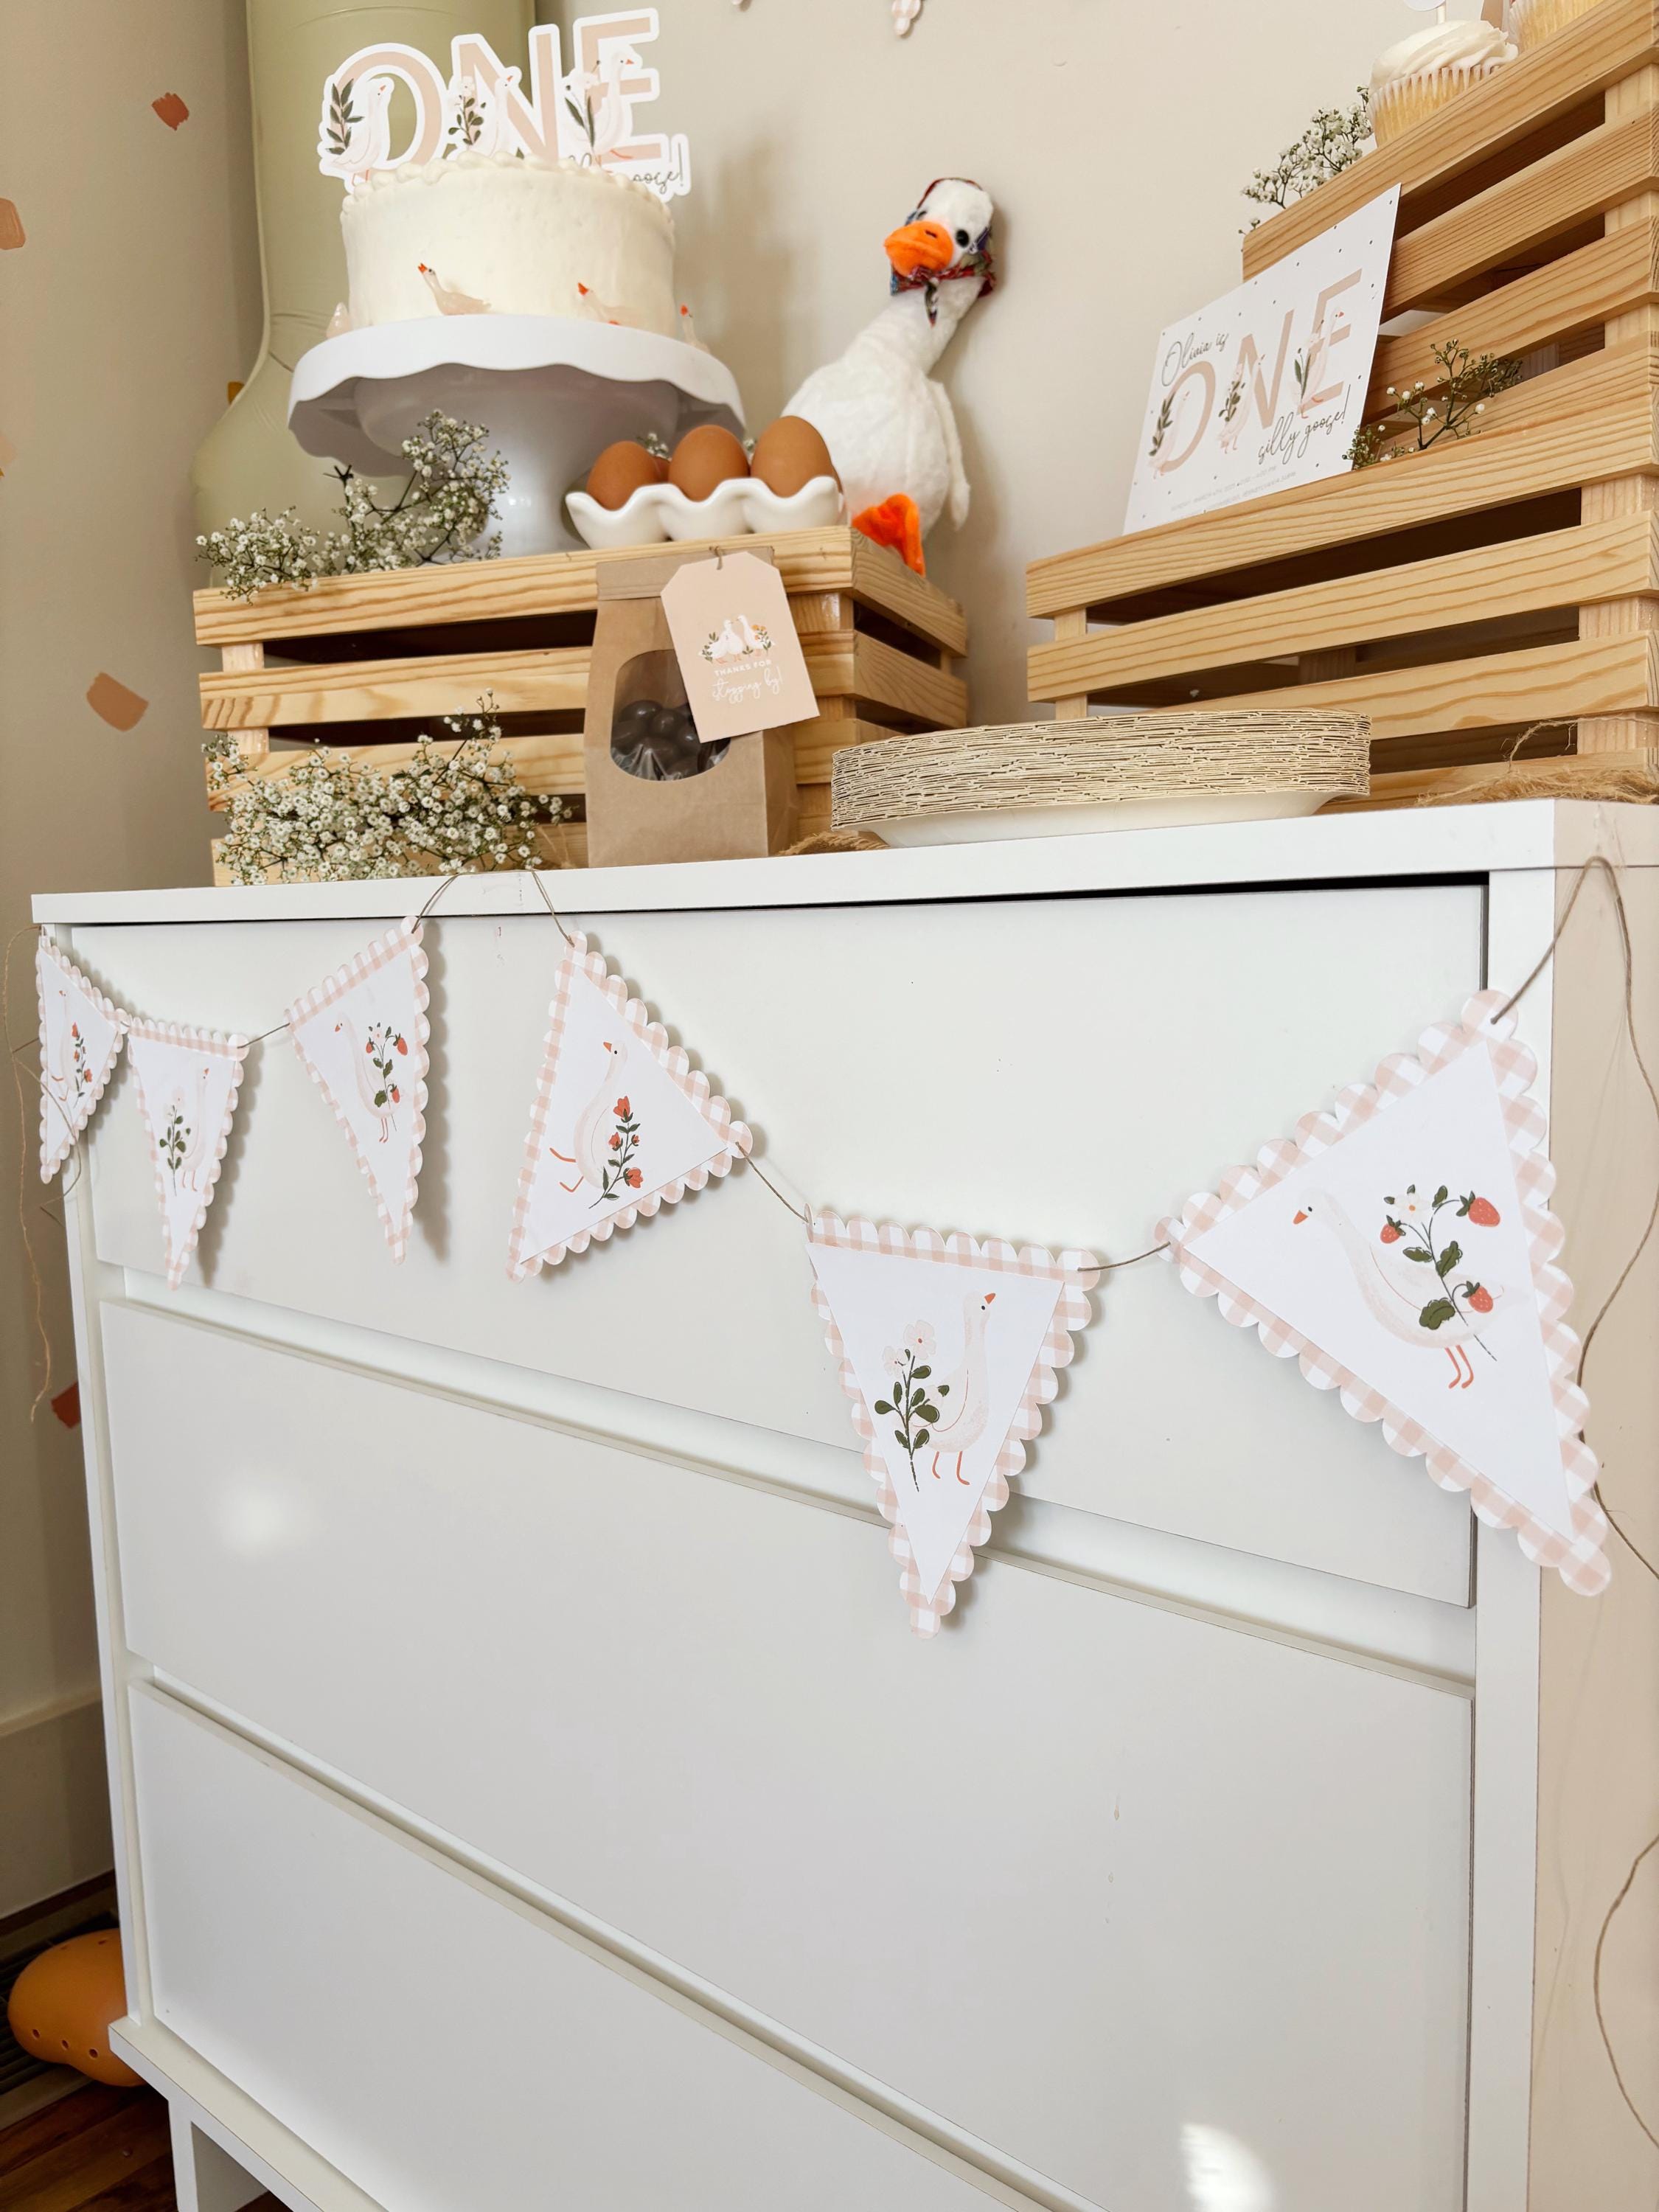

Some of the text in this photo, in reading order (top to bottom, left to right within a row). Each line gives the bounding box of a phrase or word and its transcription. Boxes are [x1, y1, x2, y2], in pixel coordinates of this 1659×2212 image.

[329, 16, 663, 165] ONE
[631, 142, 684, 195] oose!
[1155, 268, 1363, 473] ONE
[1161, 332, 1230, 387] Olivia is
[1258, 383, 1351, 465] silly goose!
[712, 666, 784, 704] stopping by!
[714, 658, 772, 677] THANKS FOR
